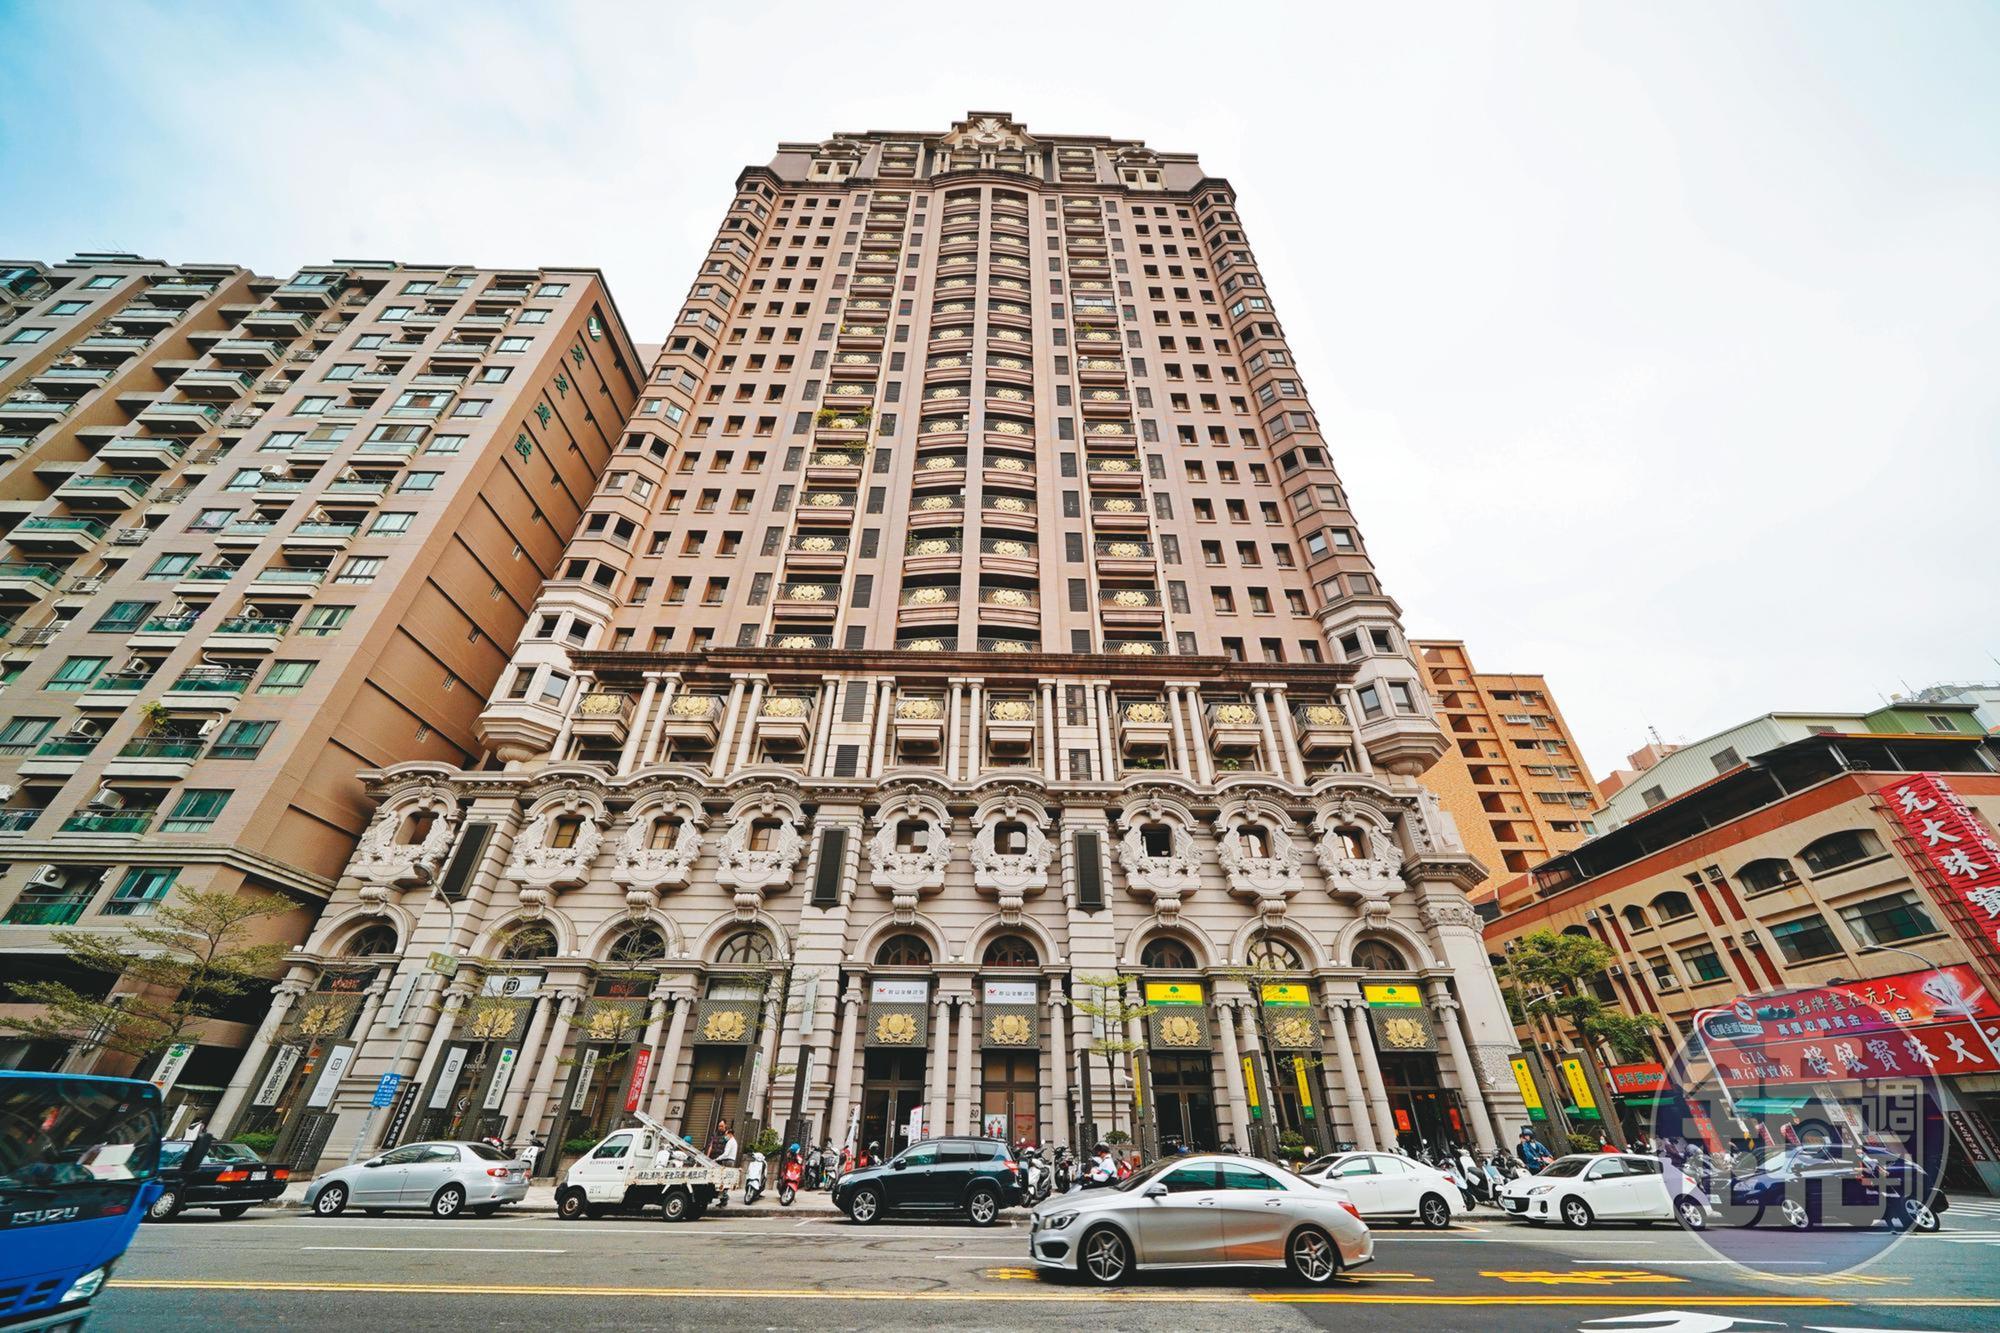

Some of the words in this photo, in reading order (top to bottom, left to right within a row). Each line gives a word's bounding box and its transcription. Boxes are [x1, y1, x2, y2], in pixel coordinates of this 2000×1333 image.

[1896, 785, 2000, 944] 元大珠寶
[1739, 1051, 1768, 1065] GIA
[382, 1075, 391, 1085] P
[11, 1206, 80, 1225] ISUZU
